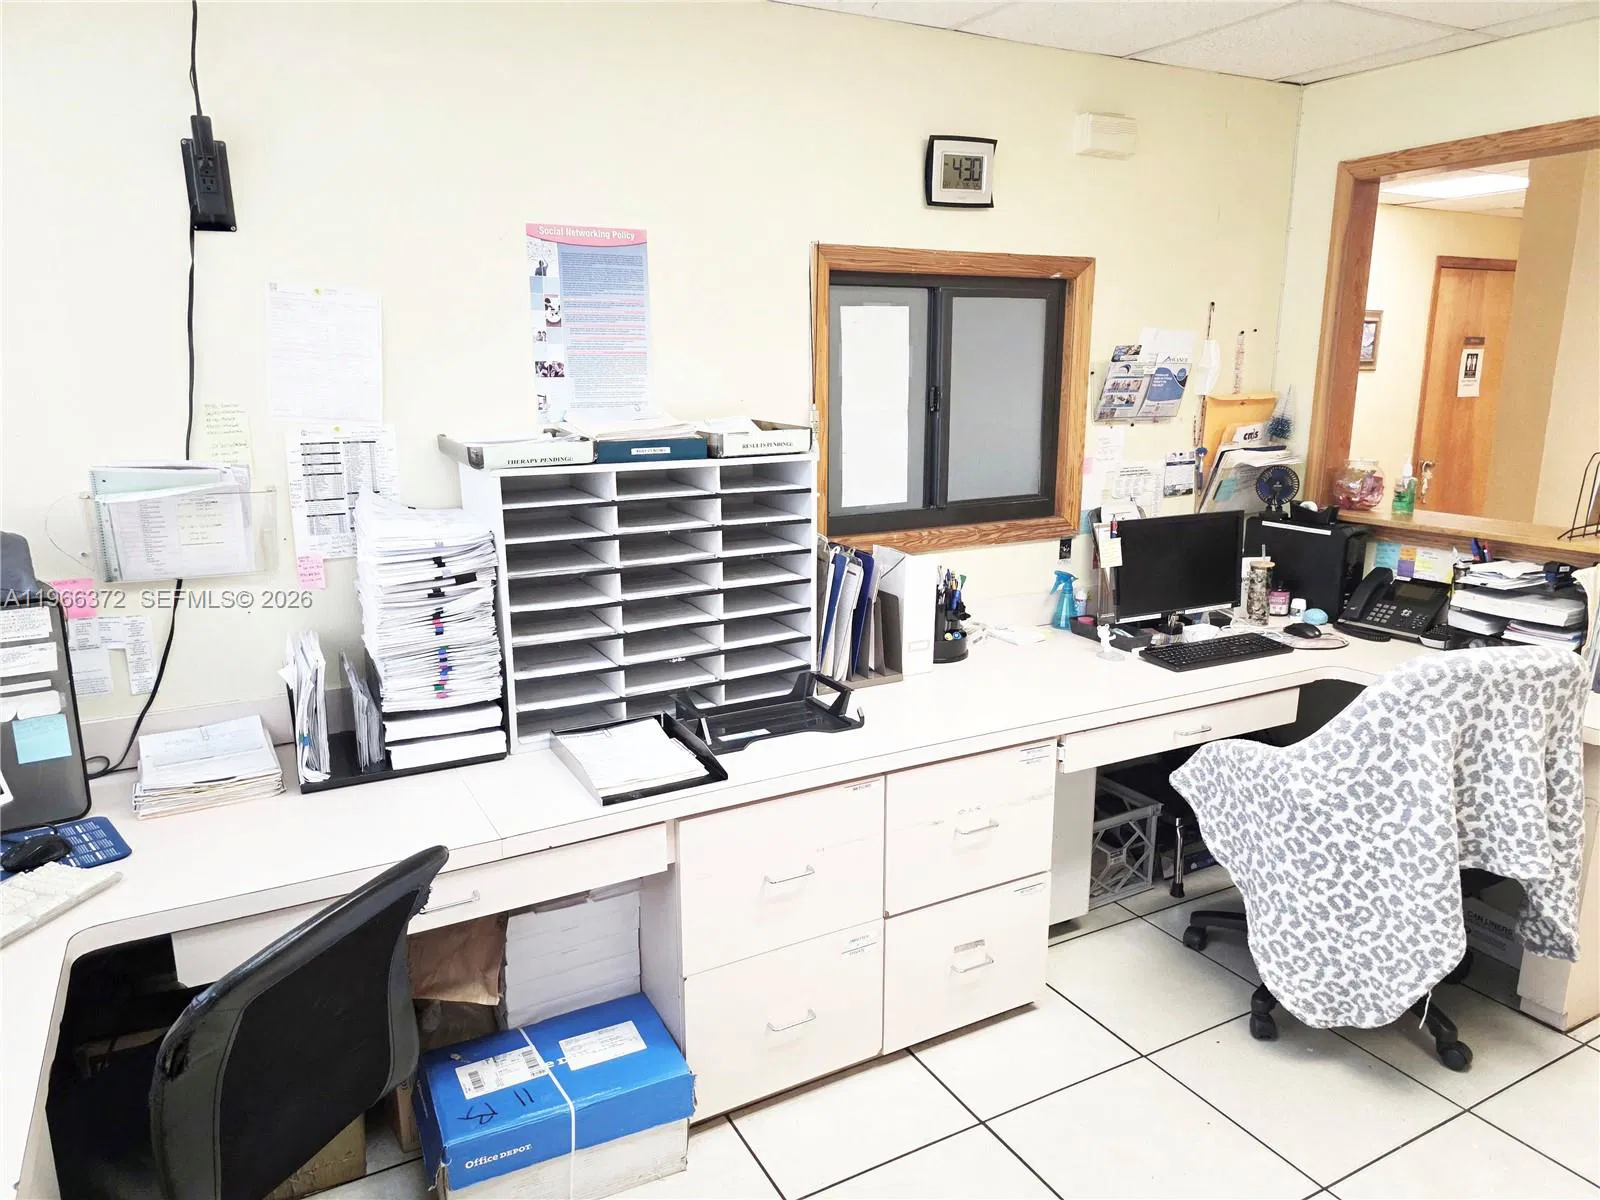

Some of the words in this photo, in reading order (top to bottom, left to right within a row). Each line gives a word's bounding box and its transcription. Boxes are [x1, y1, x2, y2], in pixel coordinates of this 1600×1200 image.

[538, 226, 564, 236] Social
[566, 227, 611, 240] Networking
[612, 230, 635, 241] Policy
[507, 457, 538, 465] THERAPY
[464, 1154, 499, 1169] Office
[499, 1143, 532, 1159] DEPOT
